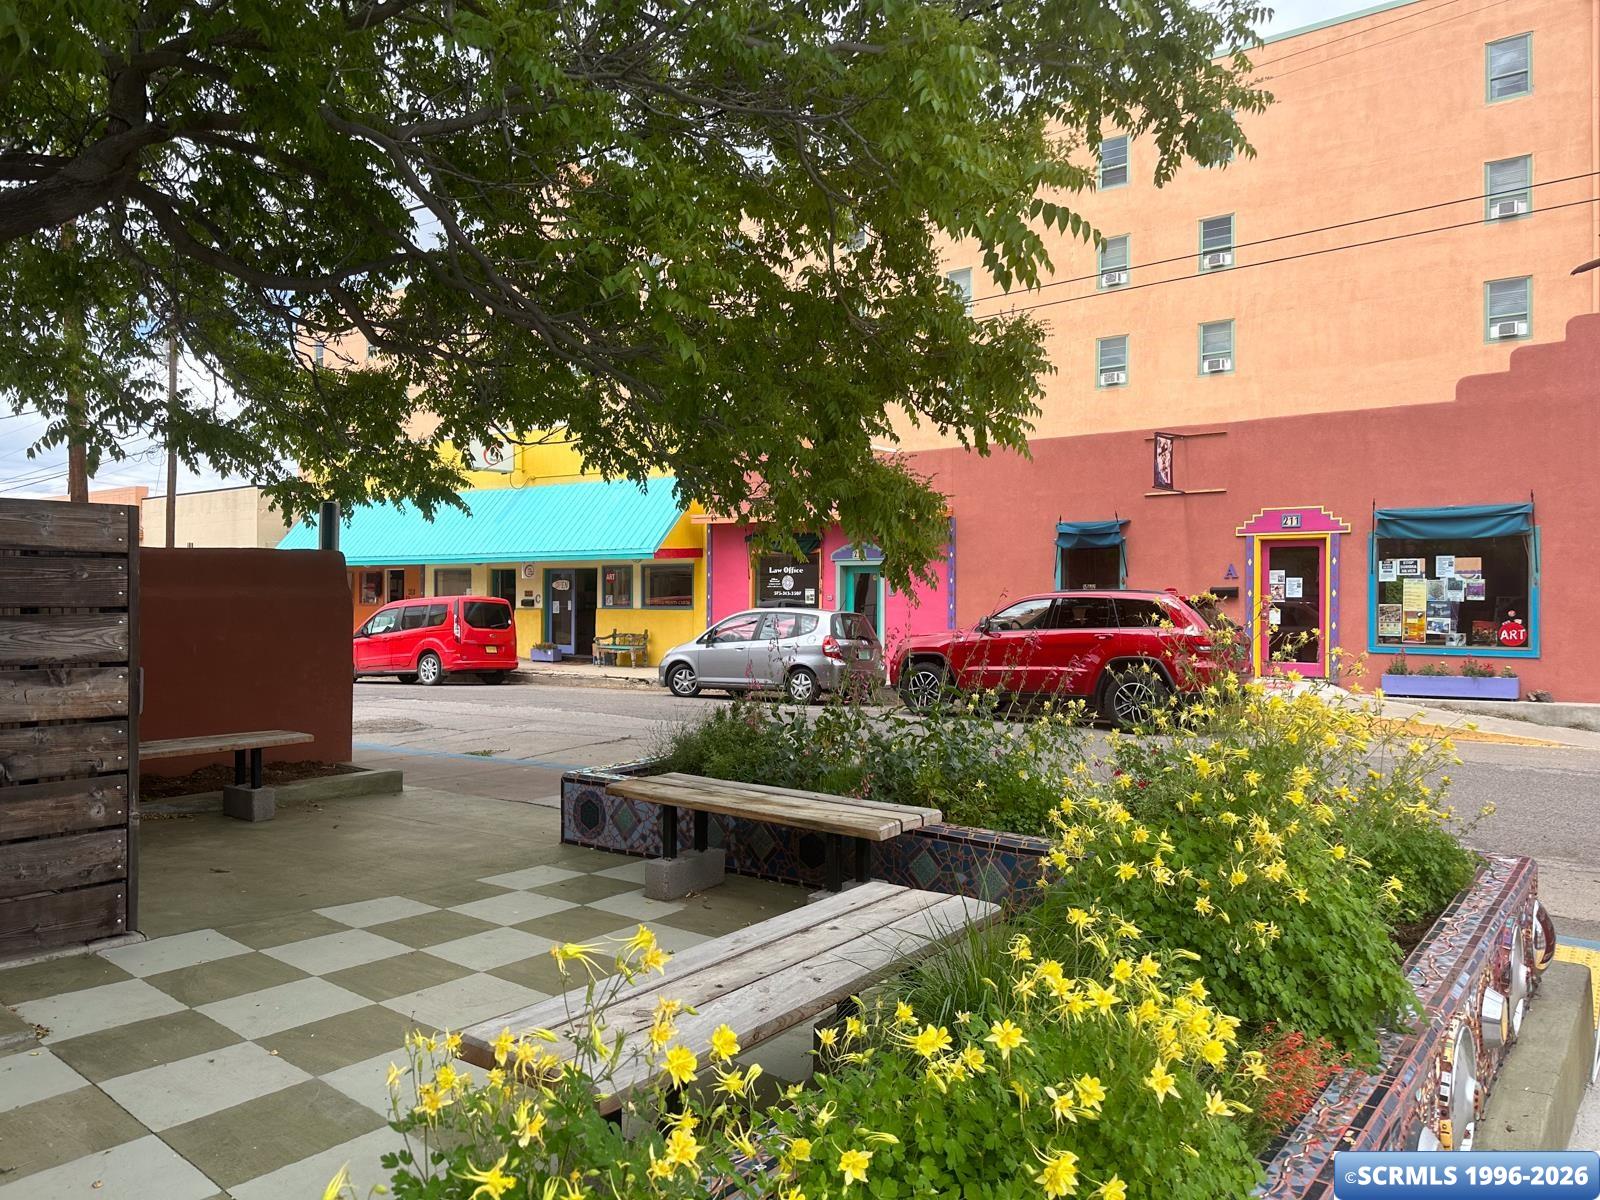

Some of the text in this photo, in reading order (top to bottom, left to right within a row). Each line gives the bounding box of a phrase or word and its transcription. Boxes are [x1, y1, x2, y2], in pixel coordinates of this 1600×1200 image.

[1283, 515, 1299, 525] 211
[769, 566, 804, 574] Law Office
[1224, 563, 1239, 580] A
[535, 593, 541, 603] C
[1500, 628, 1526, 640] ART
